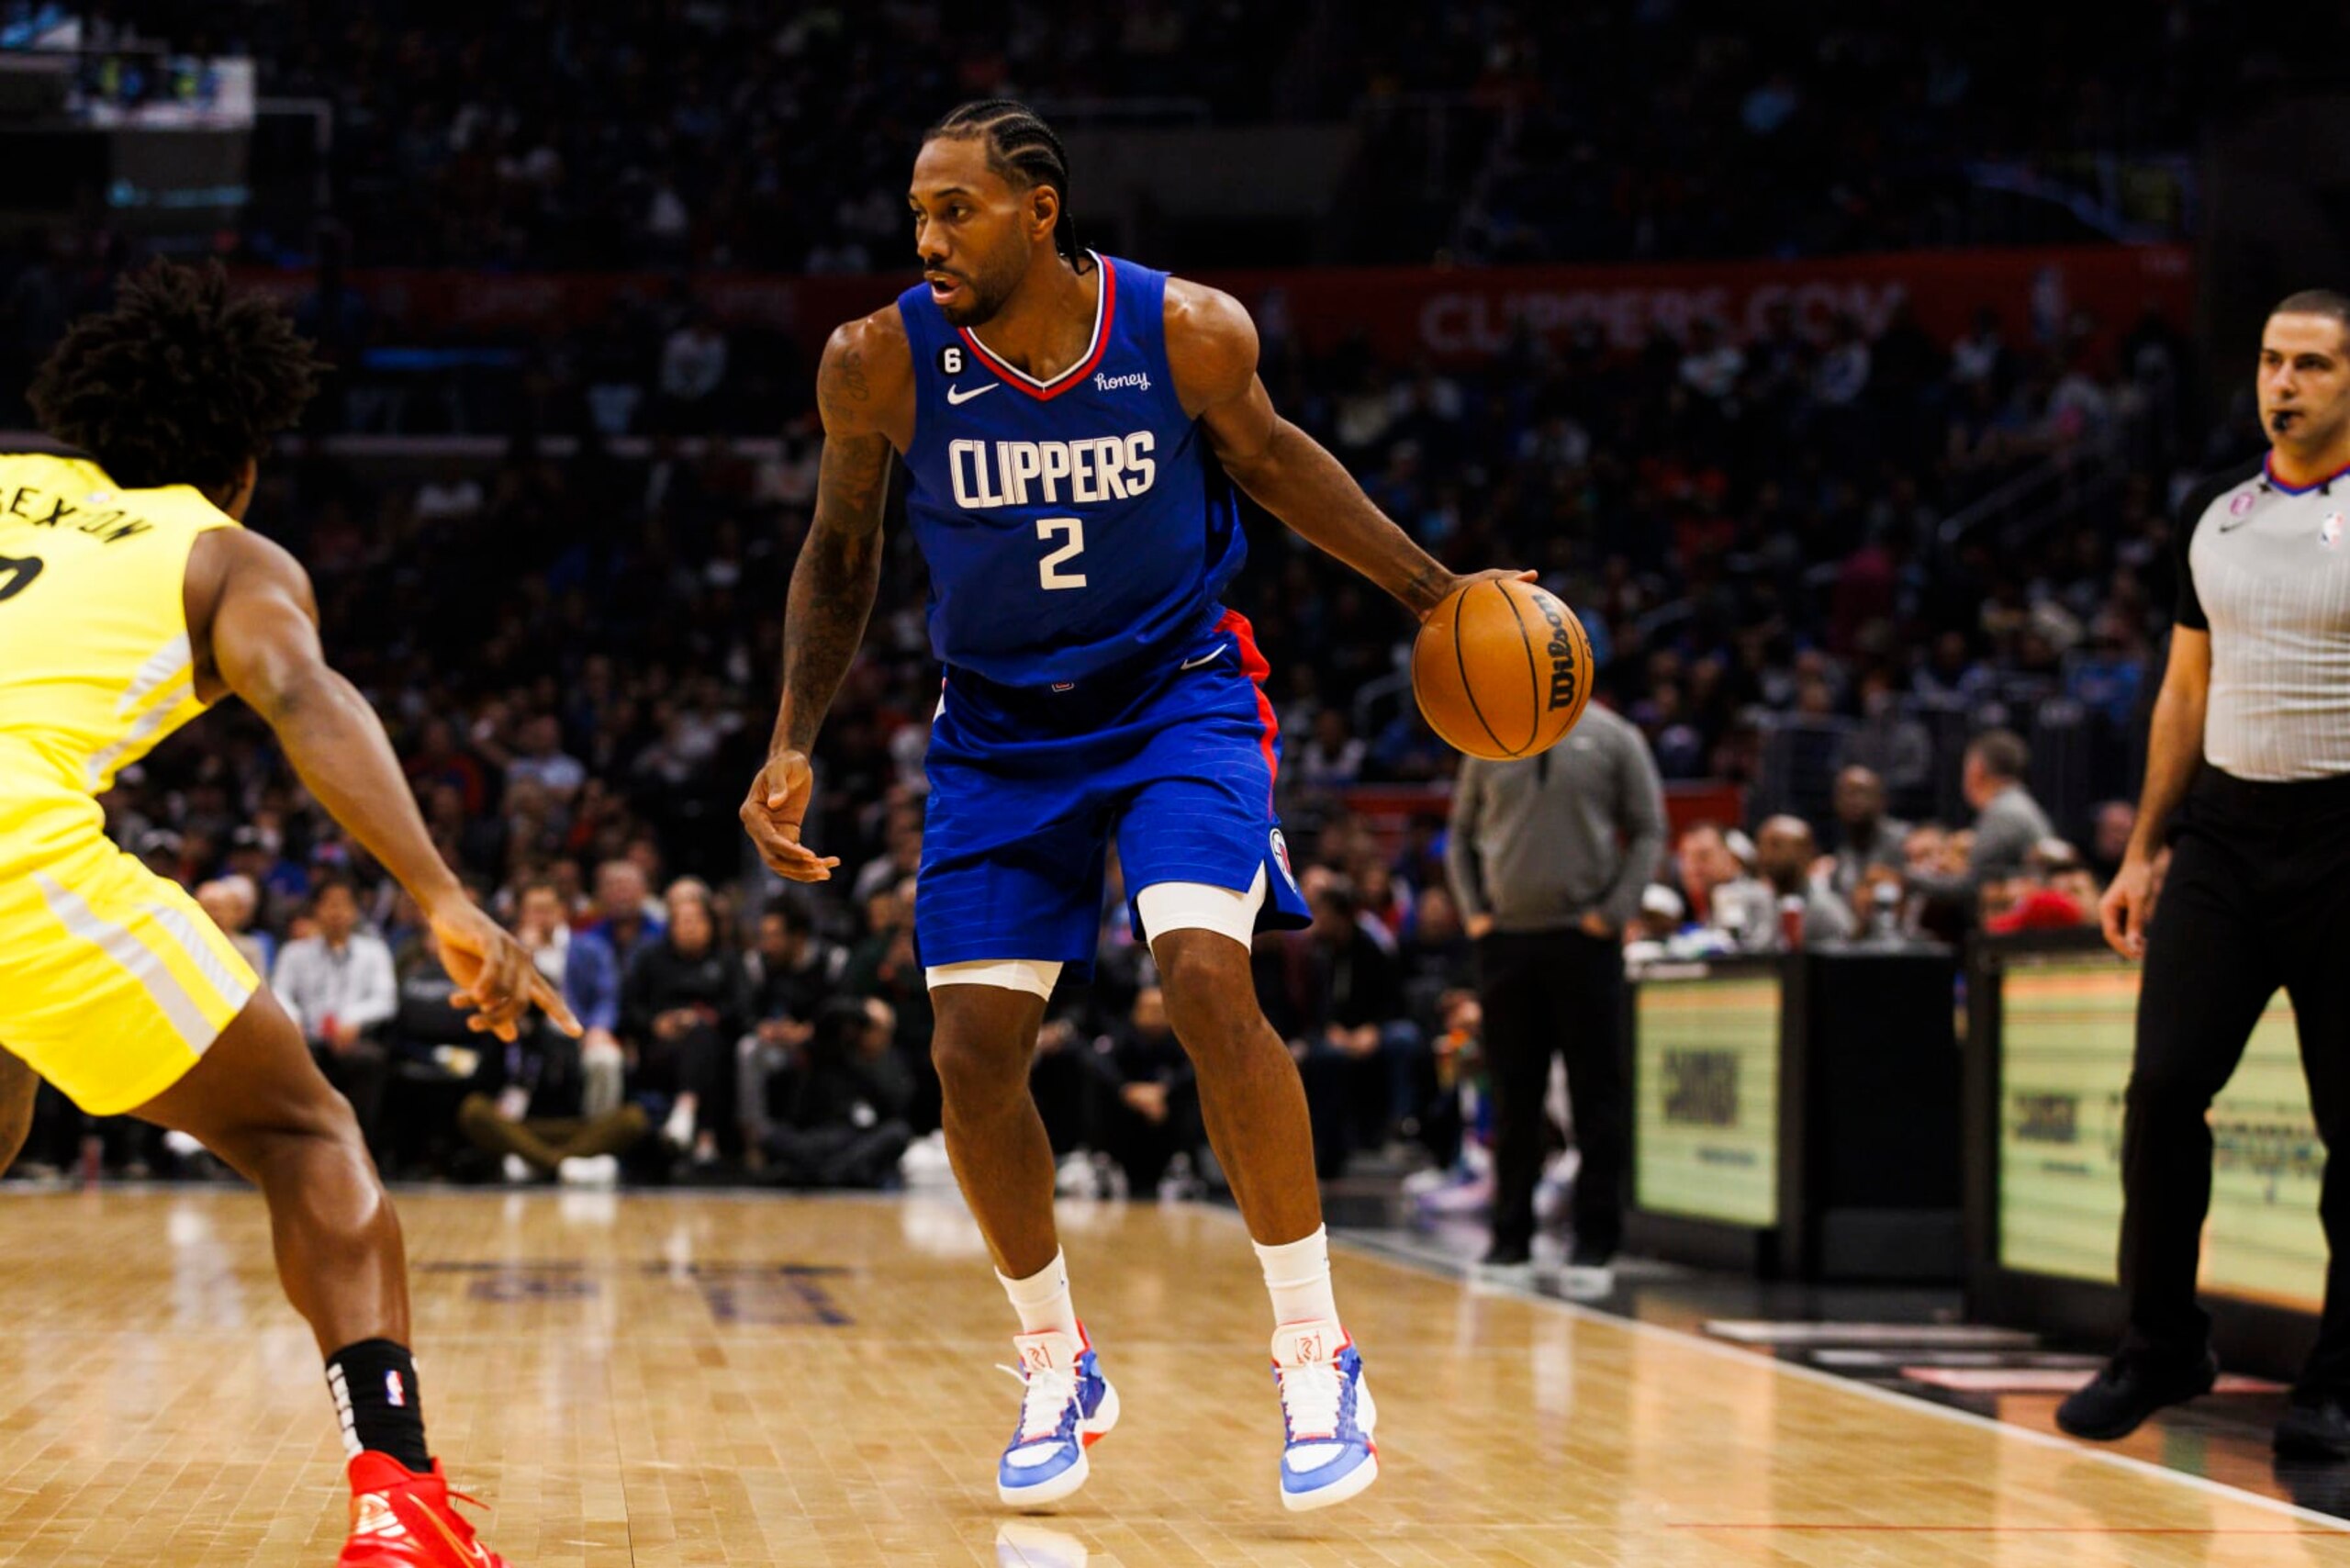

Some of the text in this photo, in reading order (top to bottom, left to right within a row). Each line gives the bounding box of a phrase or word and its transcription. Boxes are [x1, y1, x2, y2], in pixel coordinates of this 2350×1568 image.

[944, 347, 962, 374] 6
[1093, 372, 1151, 391] honey
[947, 430, 1156, 509] CLIPPERS
[1035, 517, 1087, 590] 2
[1532, 594, 1575, 712] Wilson
